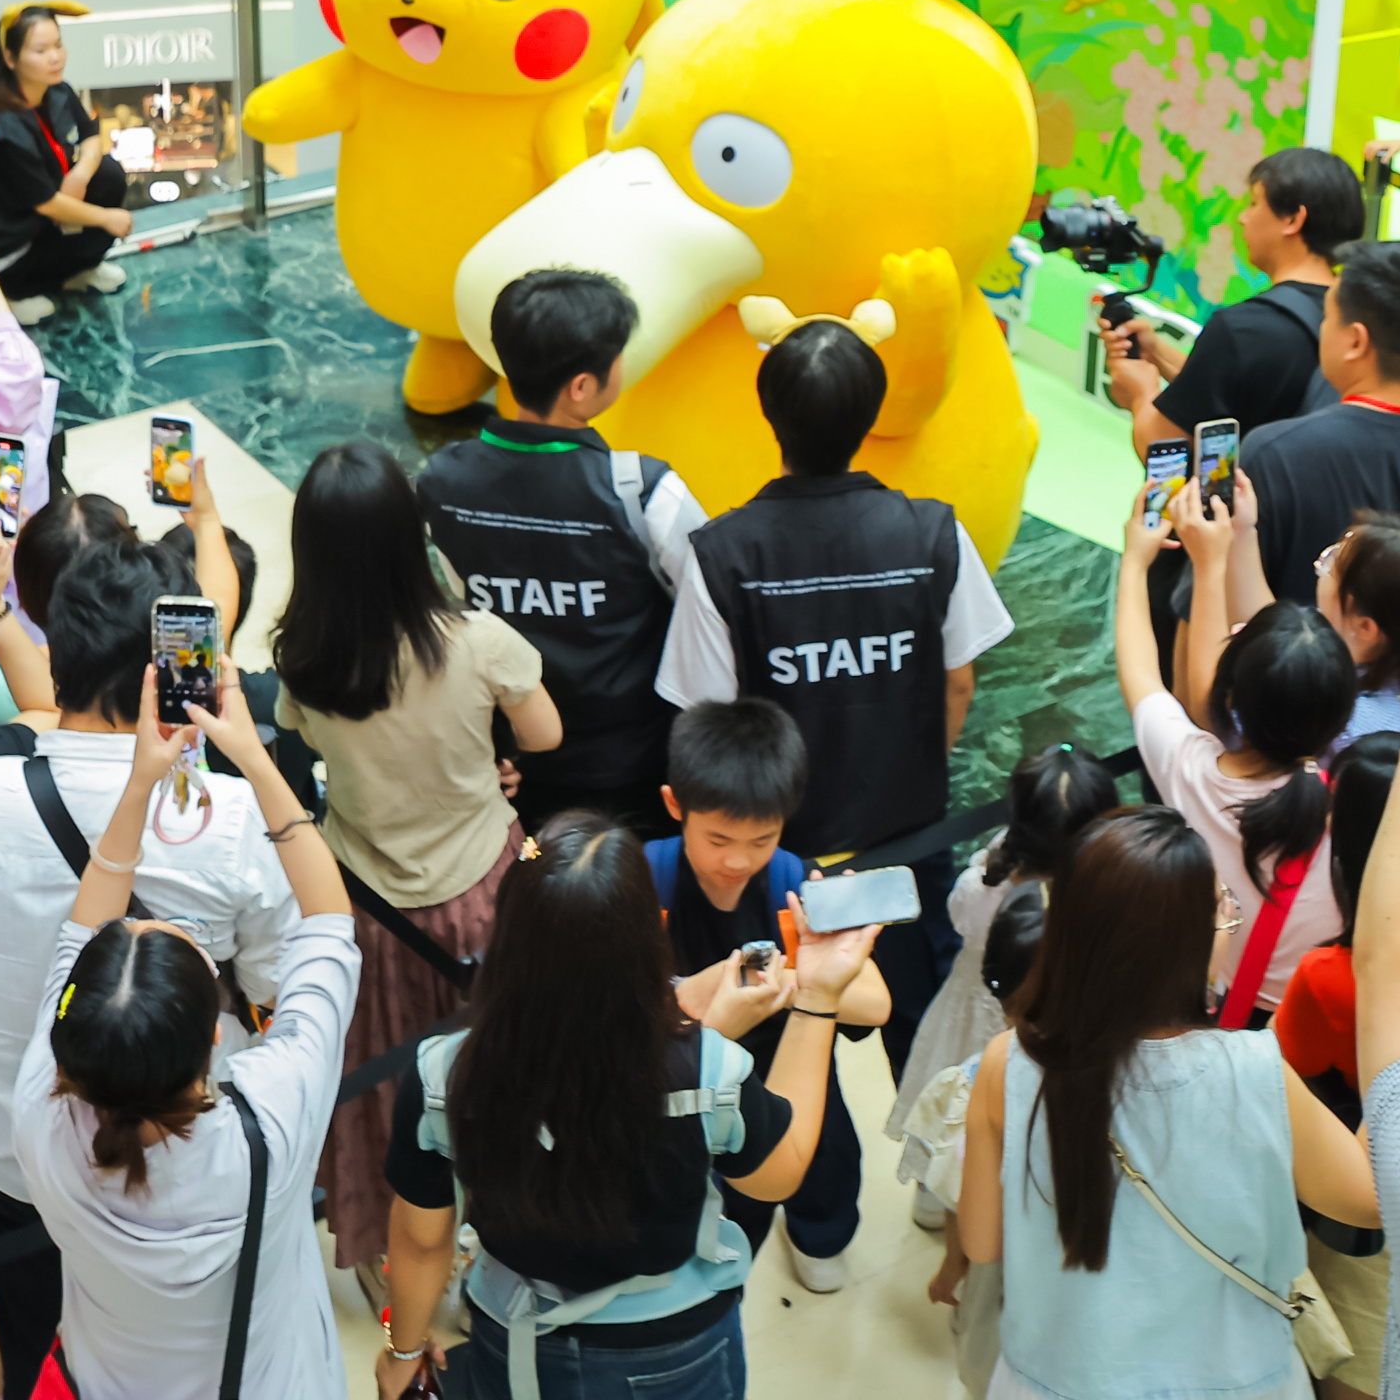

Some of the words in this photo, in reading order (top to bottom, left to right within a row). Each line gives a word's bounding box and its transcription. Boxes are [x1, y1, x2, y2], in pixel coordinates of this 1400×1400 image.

[103, 27, 216, 68] DIOR
[466, 573, 606, 618] STAFF
[767, 629, 915, 685] STAFF
